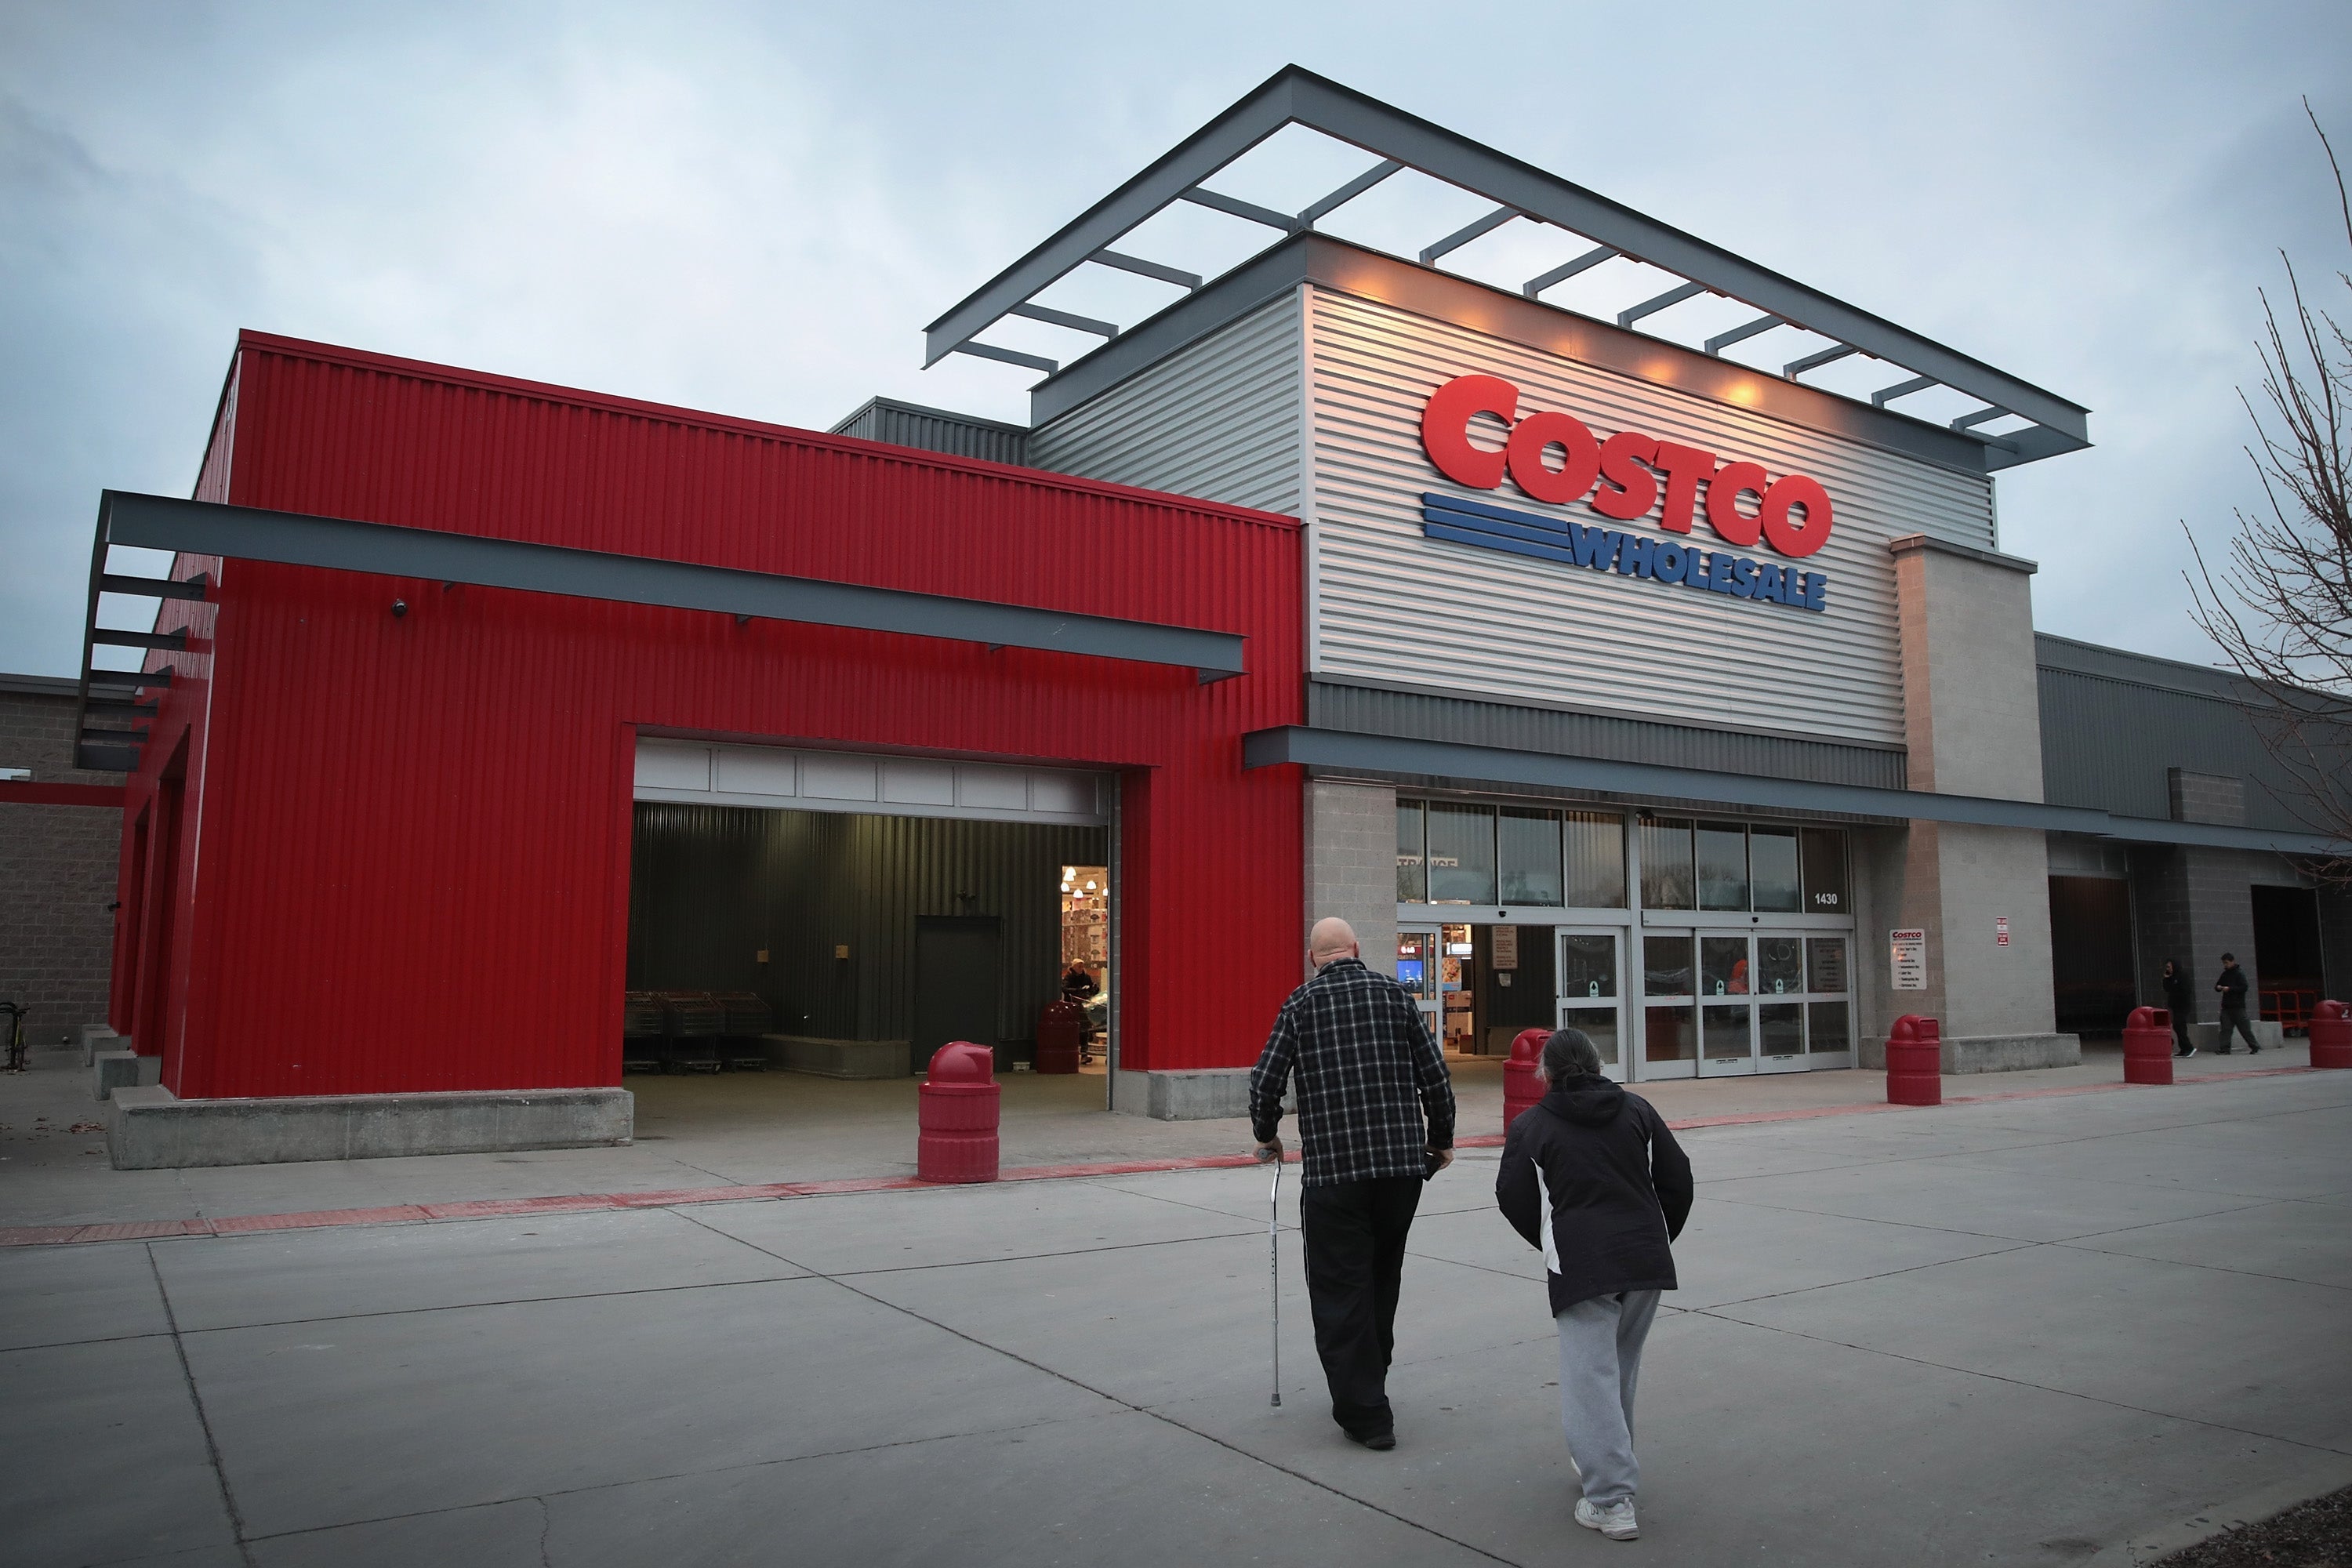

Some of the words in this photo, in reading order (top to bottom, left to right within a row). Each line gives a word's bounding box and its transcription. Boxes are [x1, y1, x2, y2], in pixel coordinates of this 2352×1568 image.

[1421, 374, 1833, 557] COSTCO
[1566, 521, 1827, 612] WHOLESALE
[1815, 892, 1838, 905] 1430
